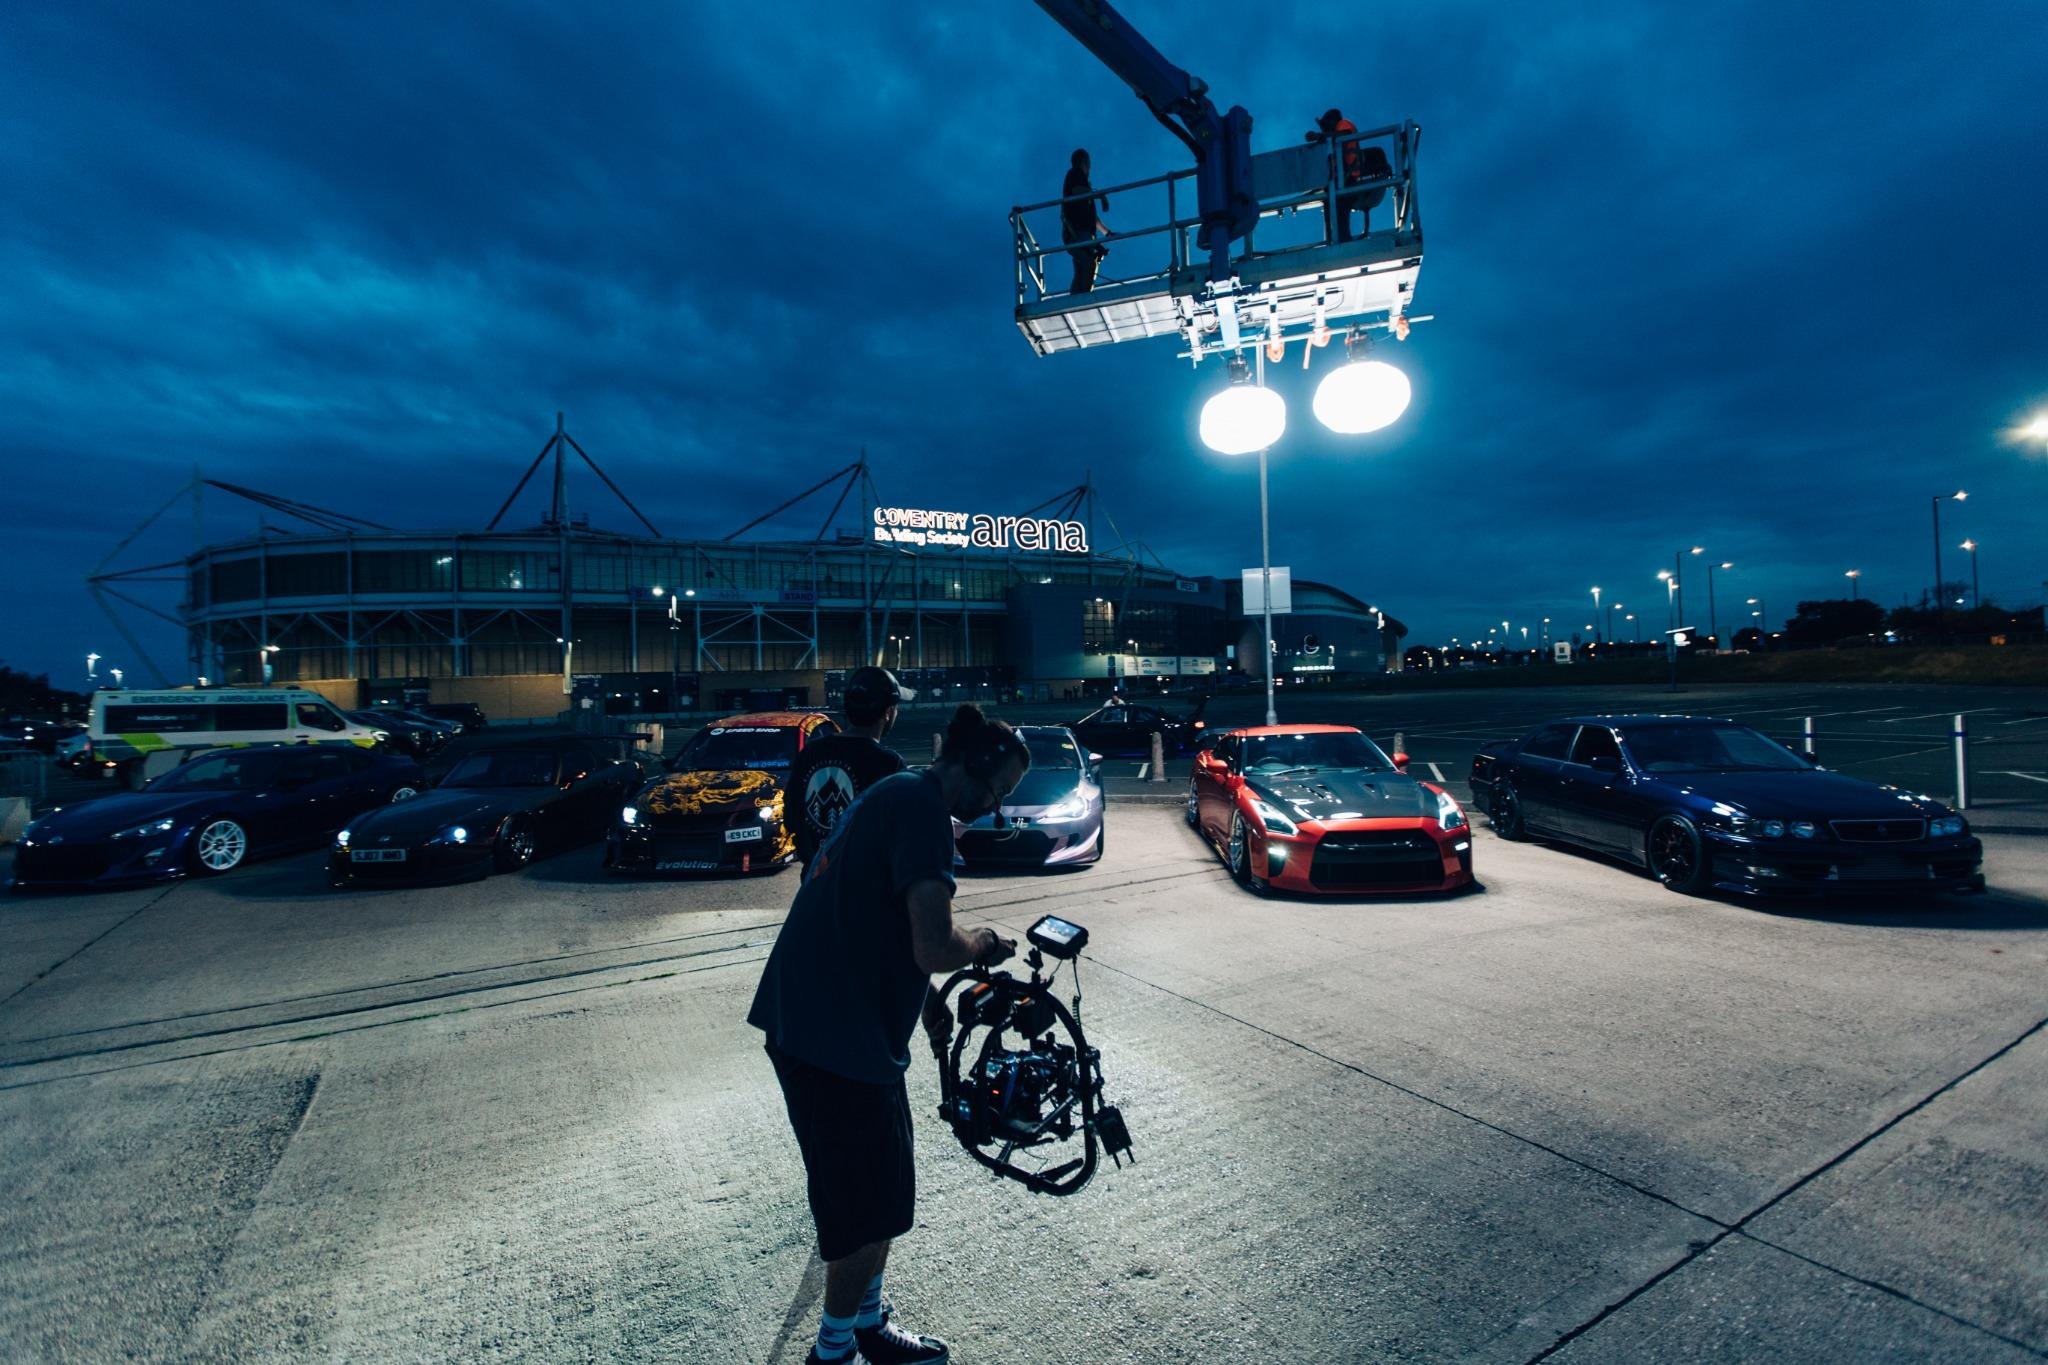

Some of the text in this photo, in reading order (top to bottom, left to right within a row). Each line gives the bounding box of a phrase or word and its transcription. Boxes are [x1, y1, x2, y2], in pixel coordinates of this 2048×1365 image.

[874, 507, 969, 530] COVENTRY
[927, 530, 970, 548] Society
[972, 514, 1089, 552] arena
[131, 695, 207, 704] EMERGENCY
[217, 694, 286, 703] AMBULANCE
[655, 860, 718, 870] Evolution
